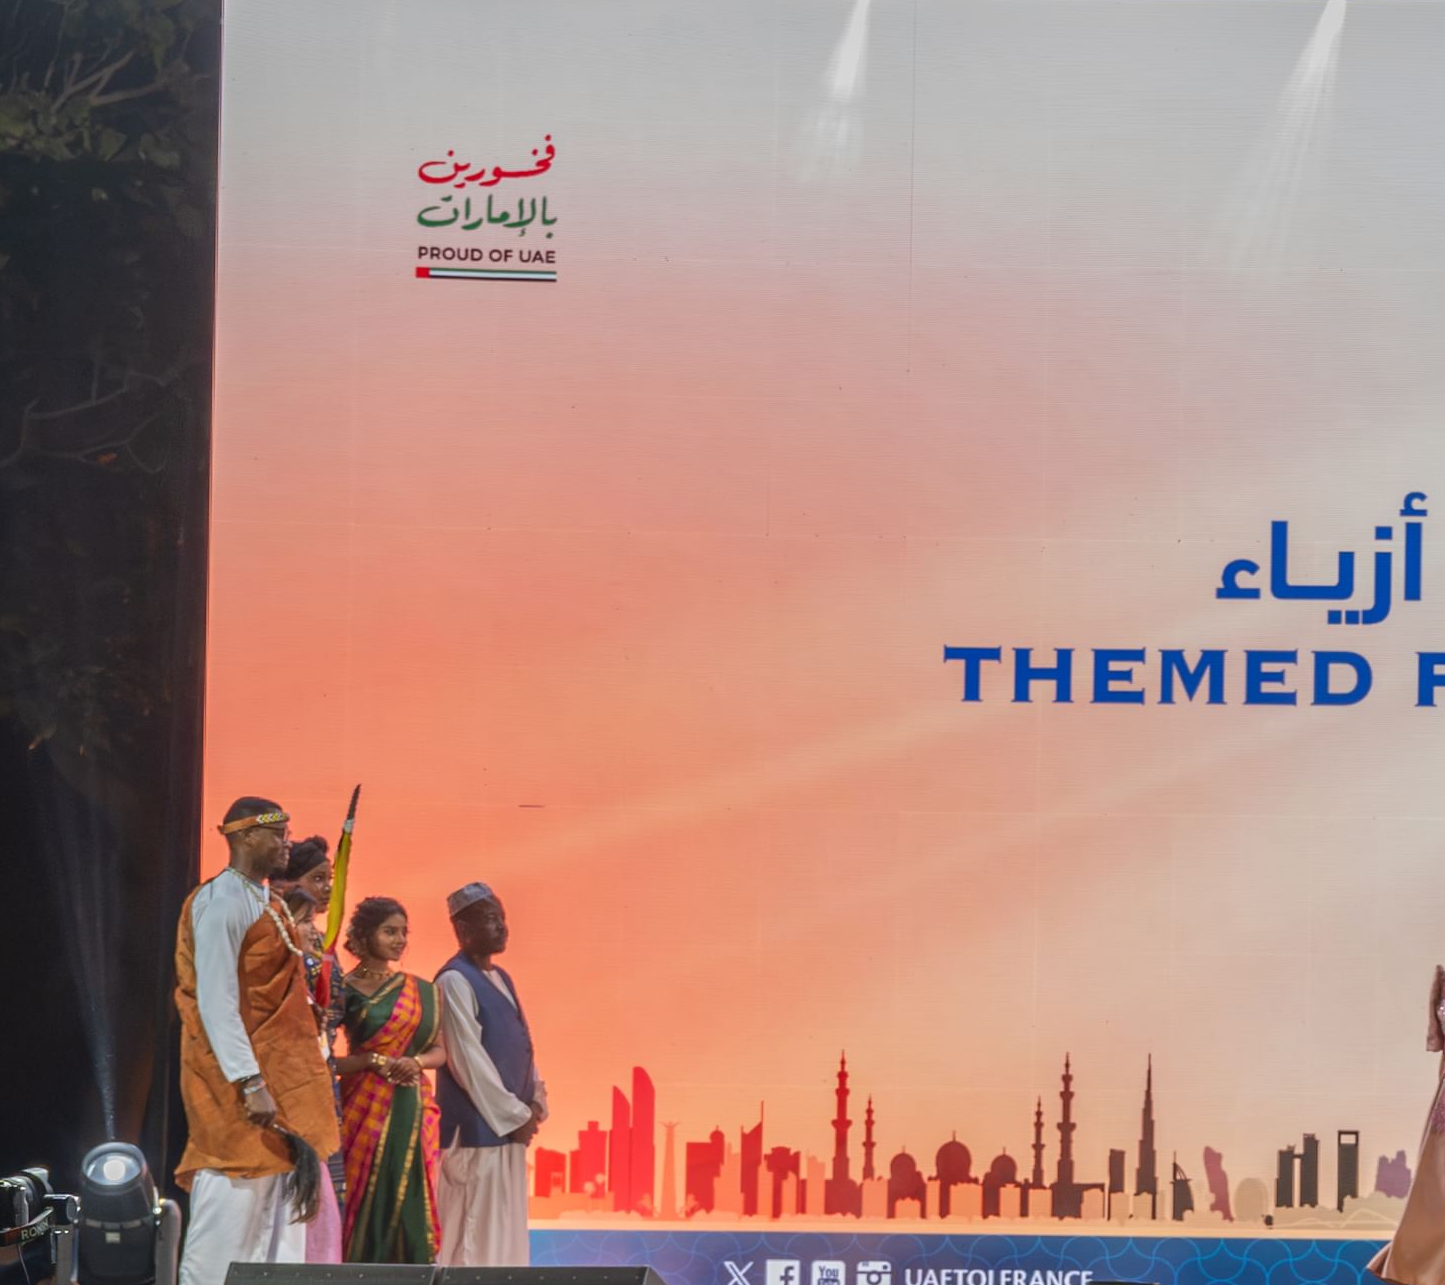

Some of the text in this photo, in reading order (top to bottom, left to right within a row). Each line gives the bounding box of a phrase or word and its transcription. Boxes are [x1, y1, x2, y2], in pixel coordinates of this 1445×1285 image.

[417, 245, 556, 264] PROUD OF UAE
[1215, 491, 1429, 626] أزياء
[943, 645, 1374, 704] THEMED
